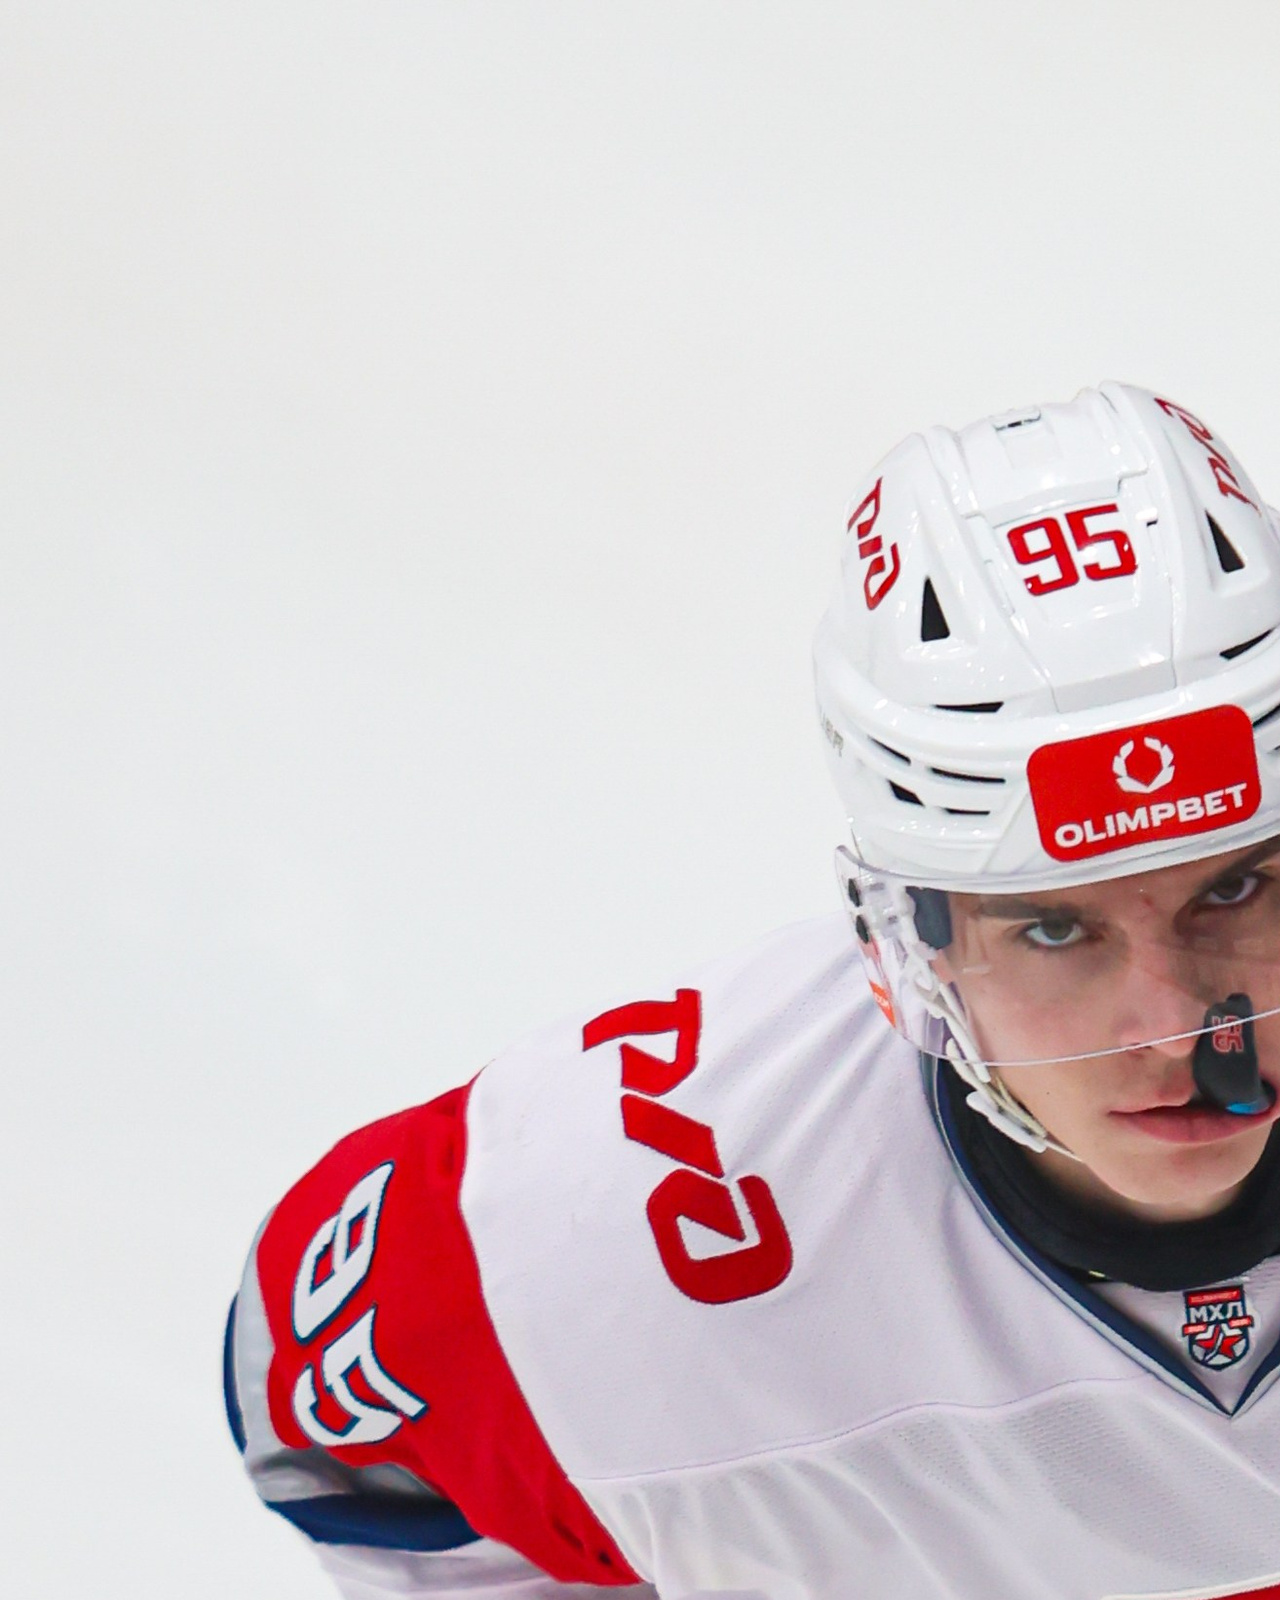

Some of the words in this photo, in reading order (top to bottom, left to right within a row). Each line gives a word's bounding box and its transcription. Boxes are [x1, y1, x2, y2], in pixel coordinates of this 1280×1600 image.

[1005, 503, 1139, 597] 95
[1054, 782, 1248, 849] OLIMPBET
[291, 1160, 429, 1450] 95
[1189, 1300, 1244, 1324] МХЛ
